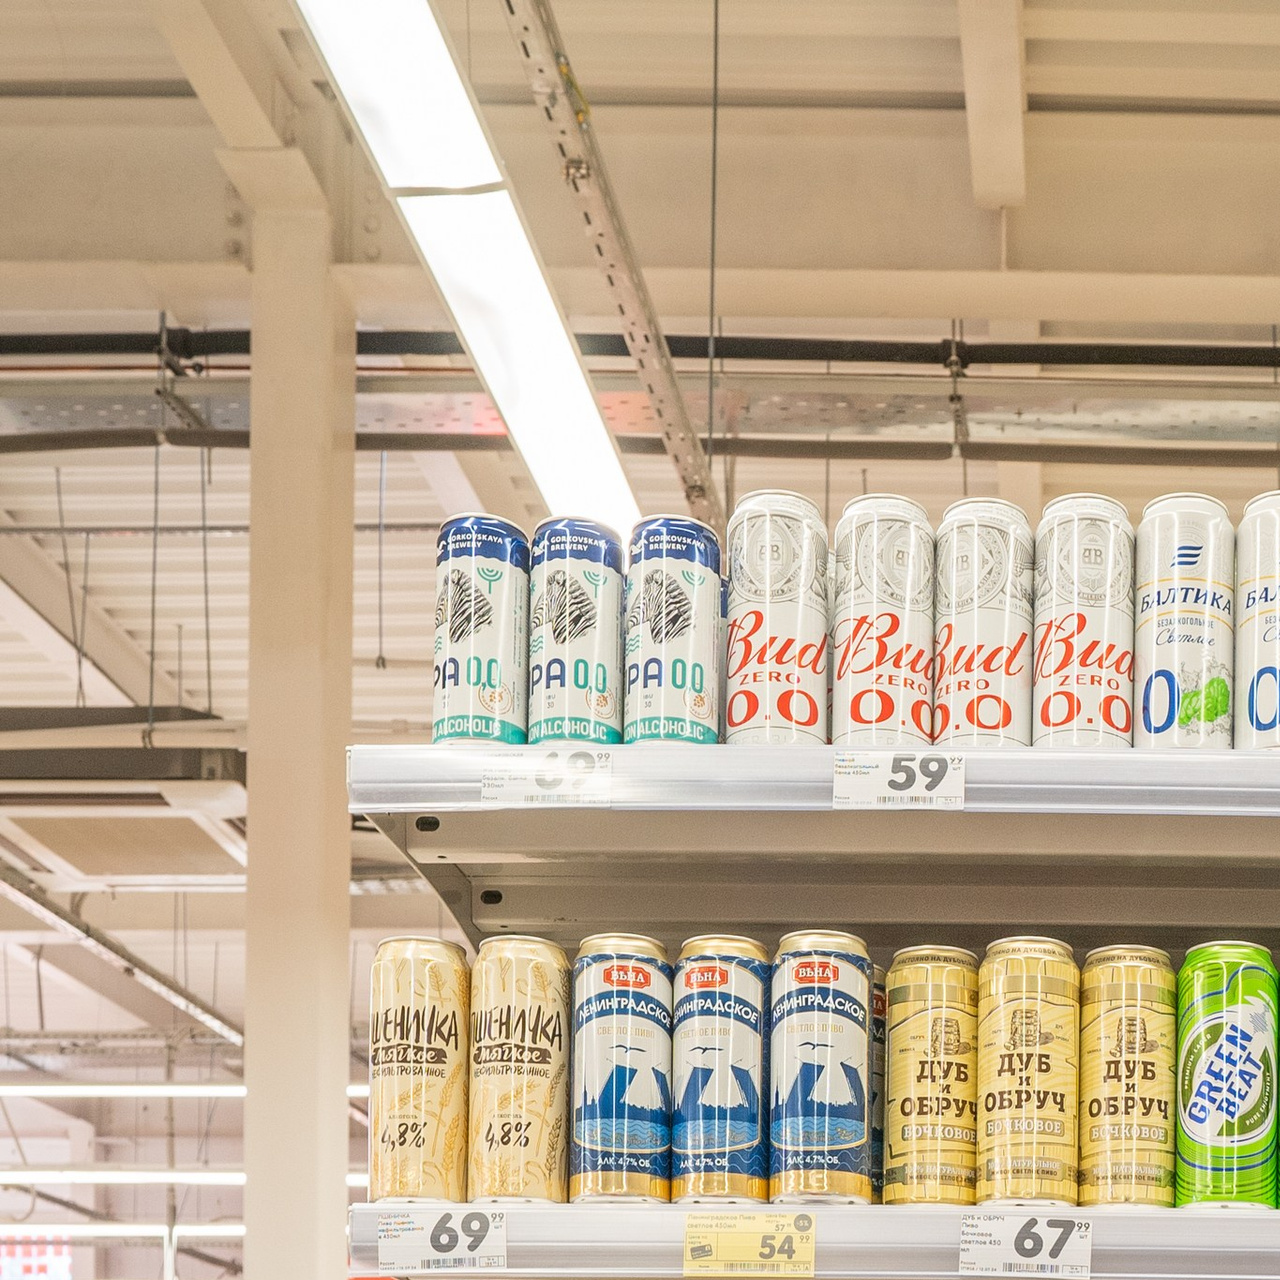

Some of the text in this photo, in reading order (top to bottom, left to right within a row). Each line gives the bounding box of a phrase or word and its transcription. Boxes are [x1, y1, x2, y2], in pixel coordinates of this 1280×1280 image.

[649, 543, 687, 551] BREWERY
[1140, 588, 1232, 615] БАЛТИКА
[727, 610, 827, 679] Bud
[1155, 627, 1215, 646] Светлое
[740, 670, 801, 685] ZERO
[727, 689, 818, 727] 0.0
[1143, 669, 1180, 733] 0
[541, 719, 606, 739] ALCOHOLIC
[887, 753, 948, 792] 59
[772, 993, 865, 1023] ЛЕНИНГРАДСКОЕ
[998, 1053, 1051, 1077] ДУБ
[1188, 1024, 1255, 1126] GREEN
[1019, 1076, 1031, 1086] и
[1217, 1054, 1263, 1120] BEAT
[984, 1090, 1066, 1113] ОБРУЧ
[987, 1120, 1062, 1137] БОЧКОВОЕ
[430, 1212, 504, 1253] 69 99
[1014, 1218, 1090, 1259] 67 99
[760, 1234, 810, 1260] 54 99
